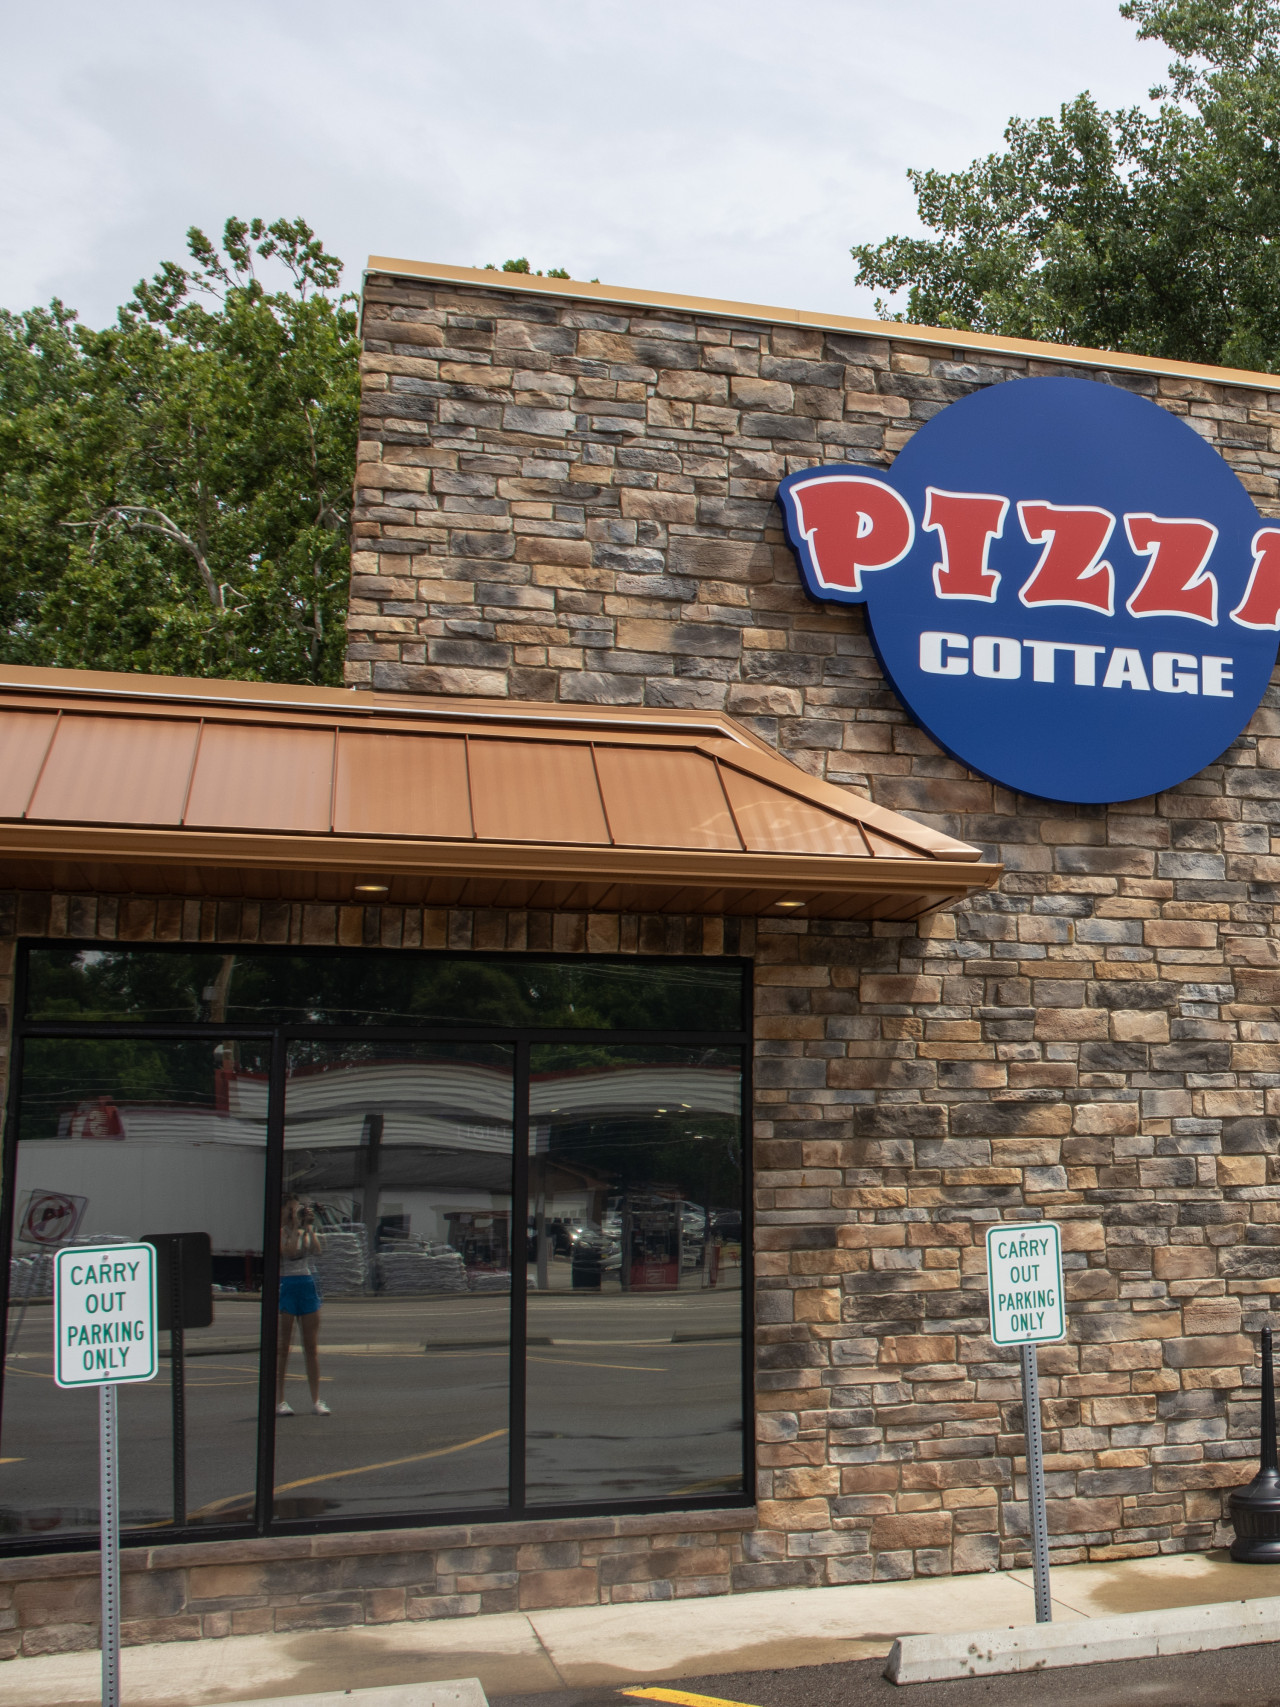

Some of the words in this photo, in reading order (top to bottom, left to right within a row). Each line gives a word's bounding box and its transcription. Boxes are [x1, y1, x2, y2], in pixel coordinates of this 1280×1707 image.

[919, 631, 1234, 698] COTTAGE
[998, 1238, 1049, 1259] CARRY
[70, 1261, 140, 1286] CARRY
[1010, 1264, 1040, 1283] OUT
[85, 1291, 126, 1314] OUT
[998, 1289, 1055, 1311] PARKING
[68, 1320, 145, 1346] PARKING
[1010, 1311, 1045, 1332] ONLY
[83, 1346, 130, 1371] ONLY
